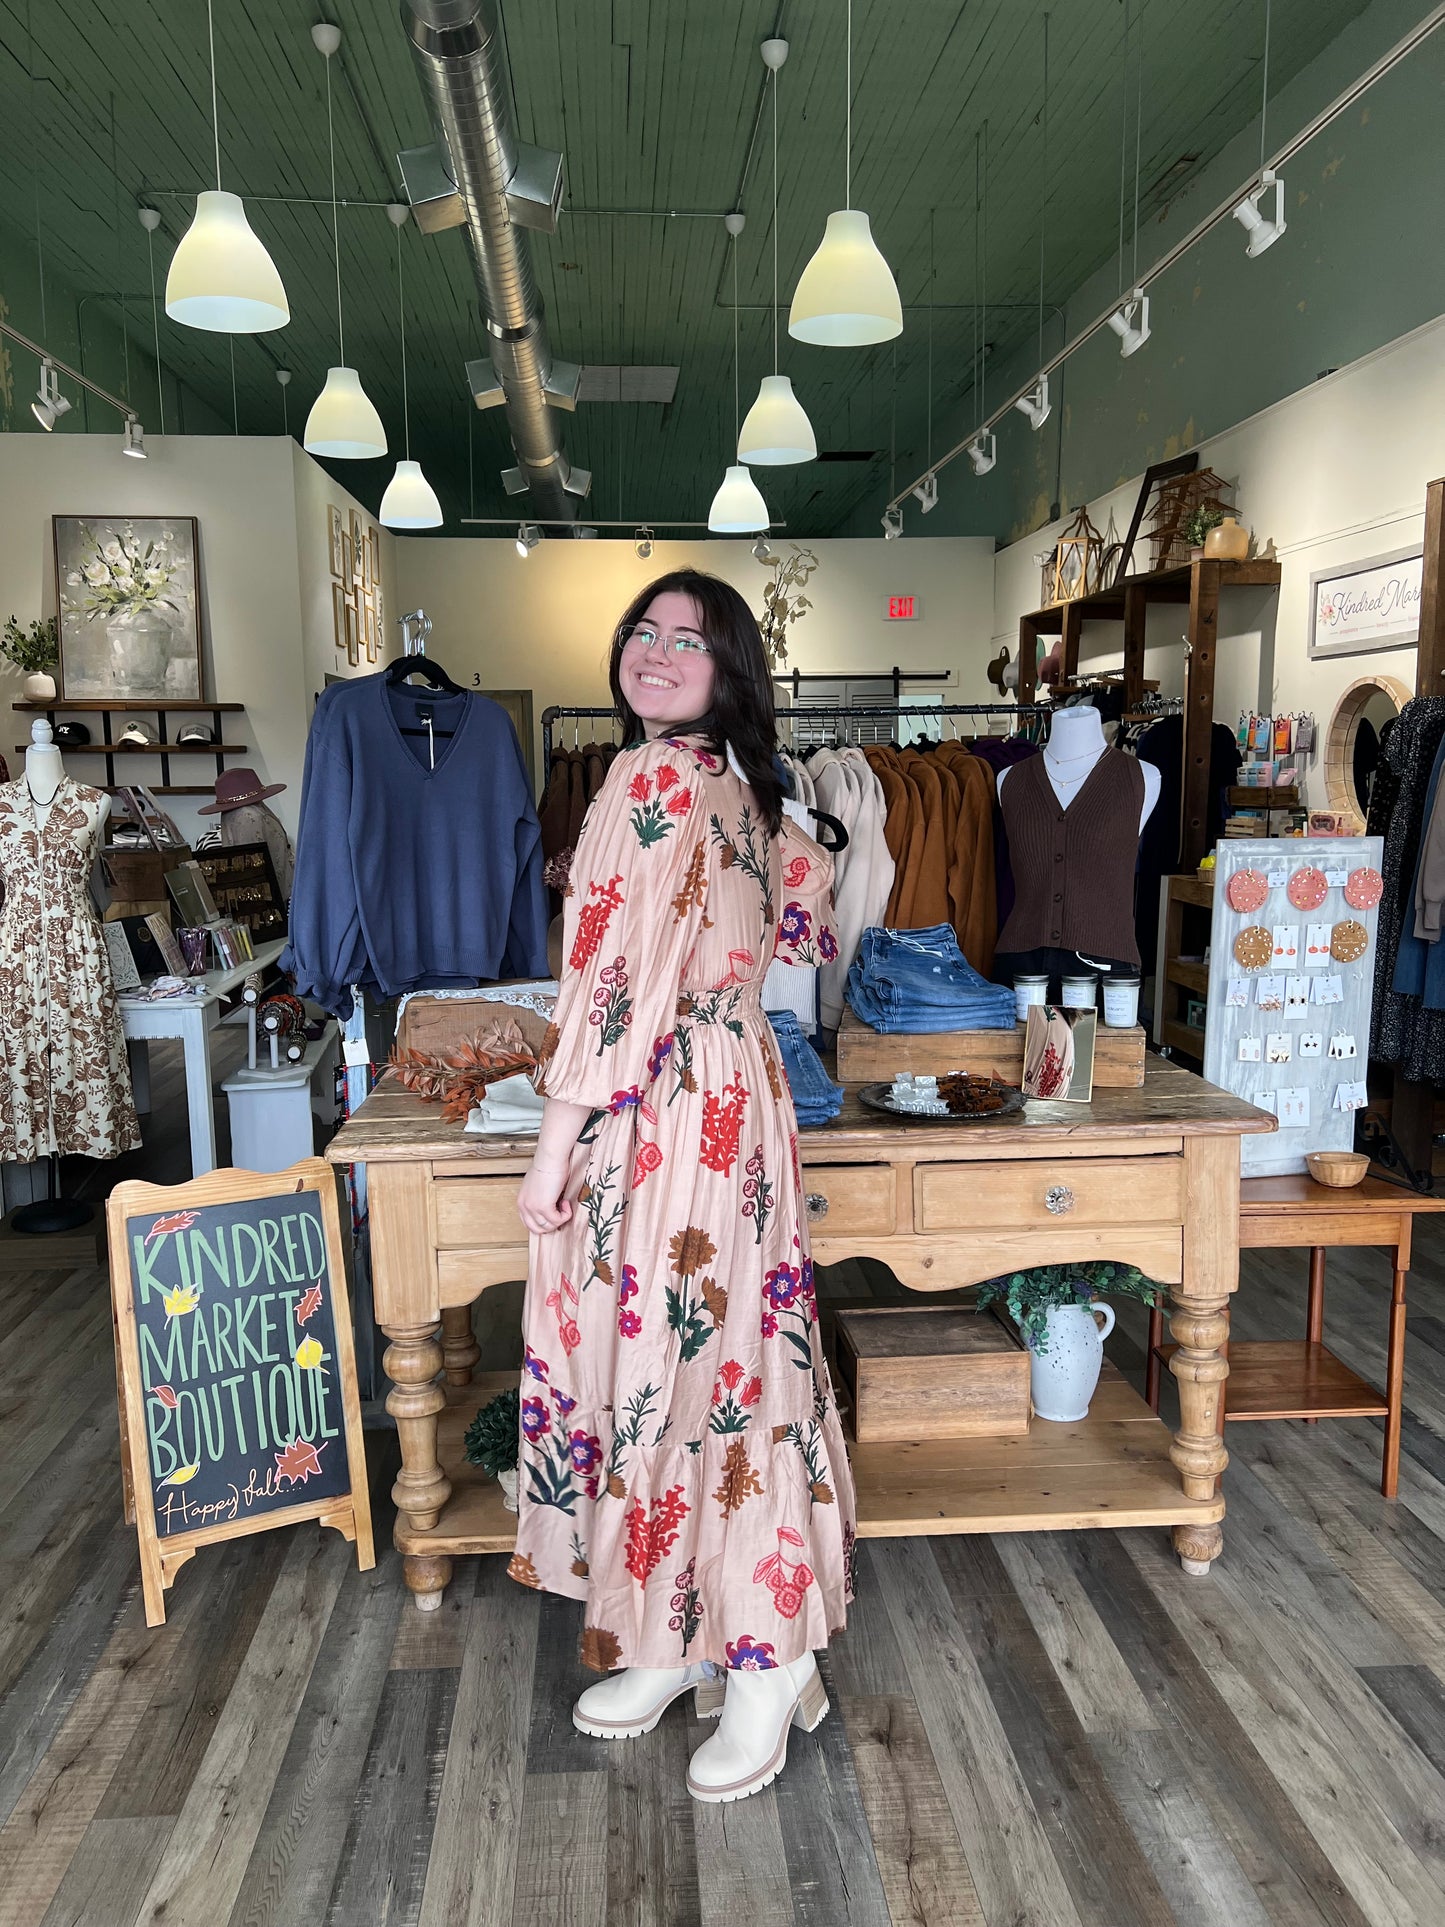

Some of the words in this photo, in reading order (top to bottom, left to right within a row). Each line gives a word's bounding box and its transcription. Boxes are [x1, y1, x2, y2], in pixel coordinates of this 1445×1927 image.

[889, 597, 915, 618] EXIT
[1330, 586, 1386, 626] Kindred
[471, 672, 481, 687] 3
[133, 1212, 326, 1305] KINDRED
[139, 1289, 301, 1391] MARKET
[147, 1352, 339, 1478] BOUTIQUE
[157, 1483, 239, 1534] Happy
